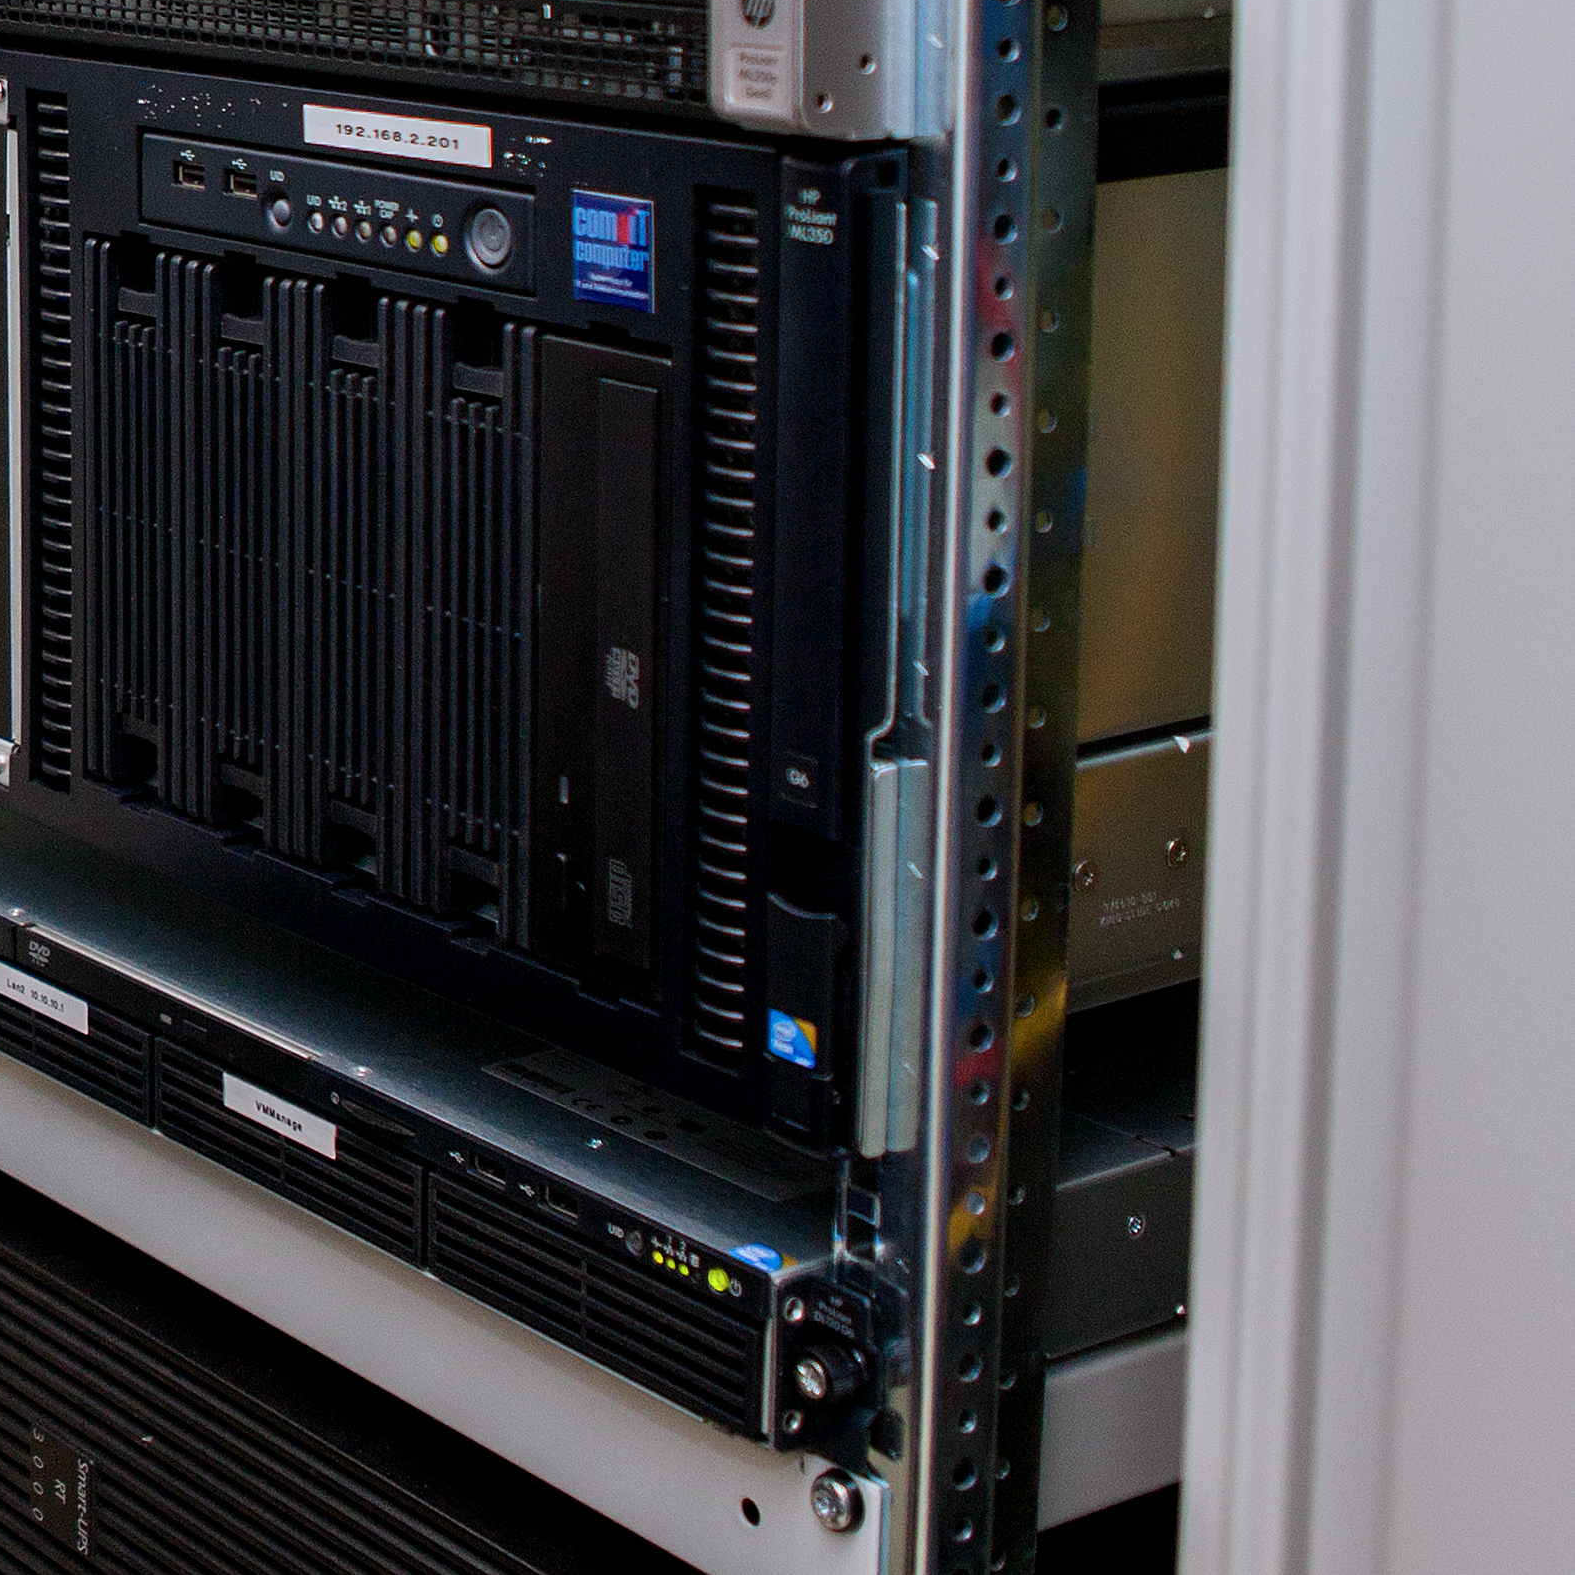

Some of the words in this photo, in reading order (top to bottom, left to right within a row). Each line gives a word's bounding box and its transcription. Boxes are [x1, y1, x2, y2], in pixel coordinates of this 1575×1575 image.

[336, 123, 460, 150] 192.168.2.201
[269, 170, 285, 182] UID
[306, 194, 322, 206] UID
[574, 241, 649, 271] computer
[29, 940, 51, 957] DVD
[6, 978, 26, 995] Lan2
[255, 1100, 304, 1132] VMManage
[55, 1478, 67, 1506] RT
[77, 1459, 89, 1556] Smart-UPS
